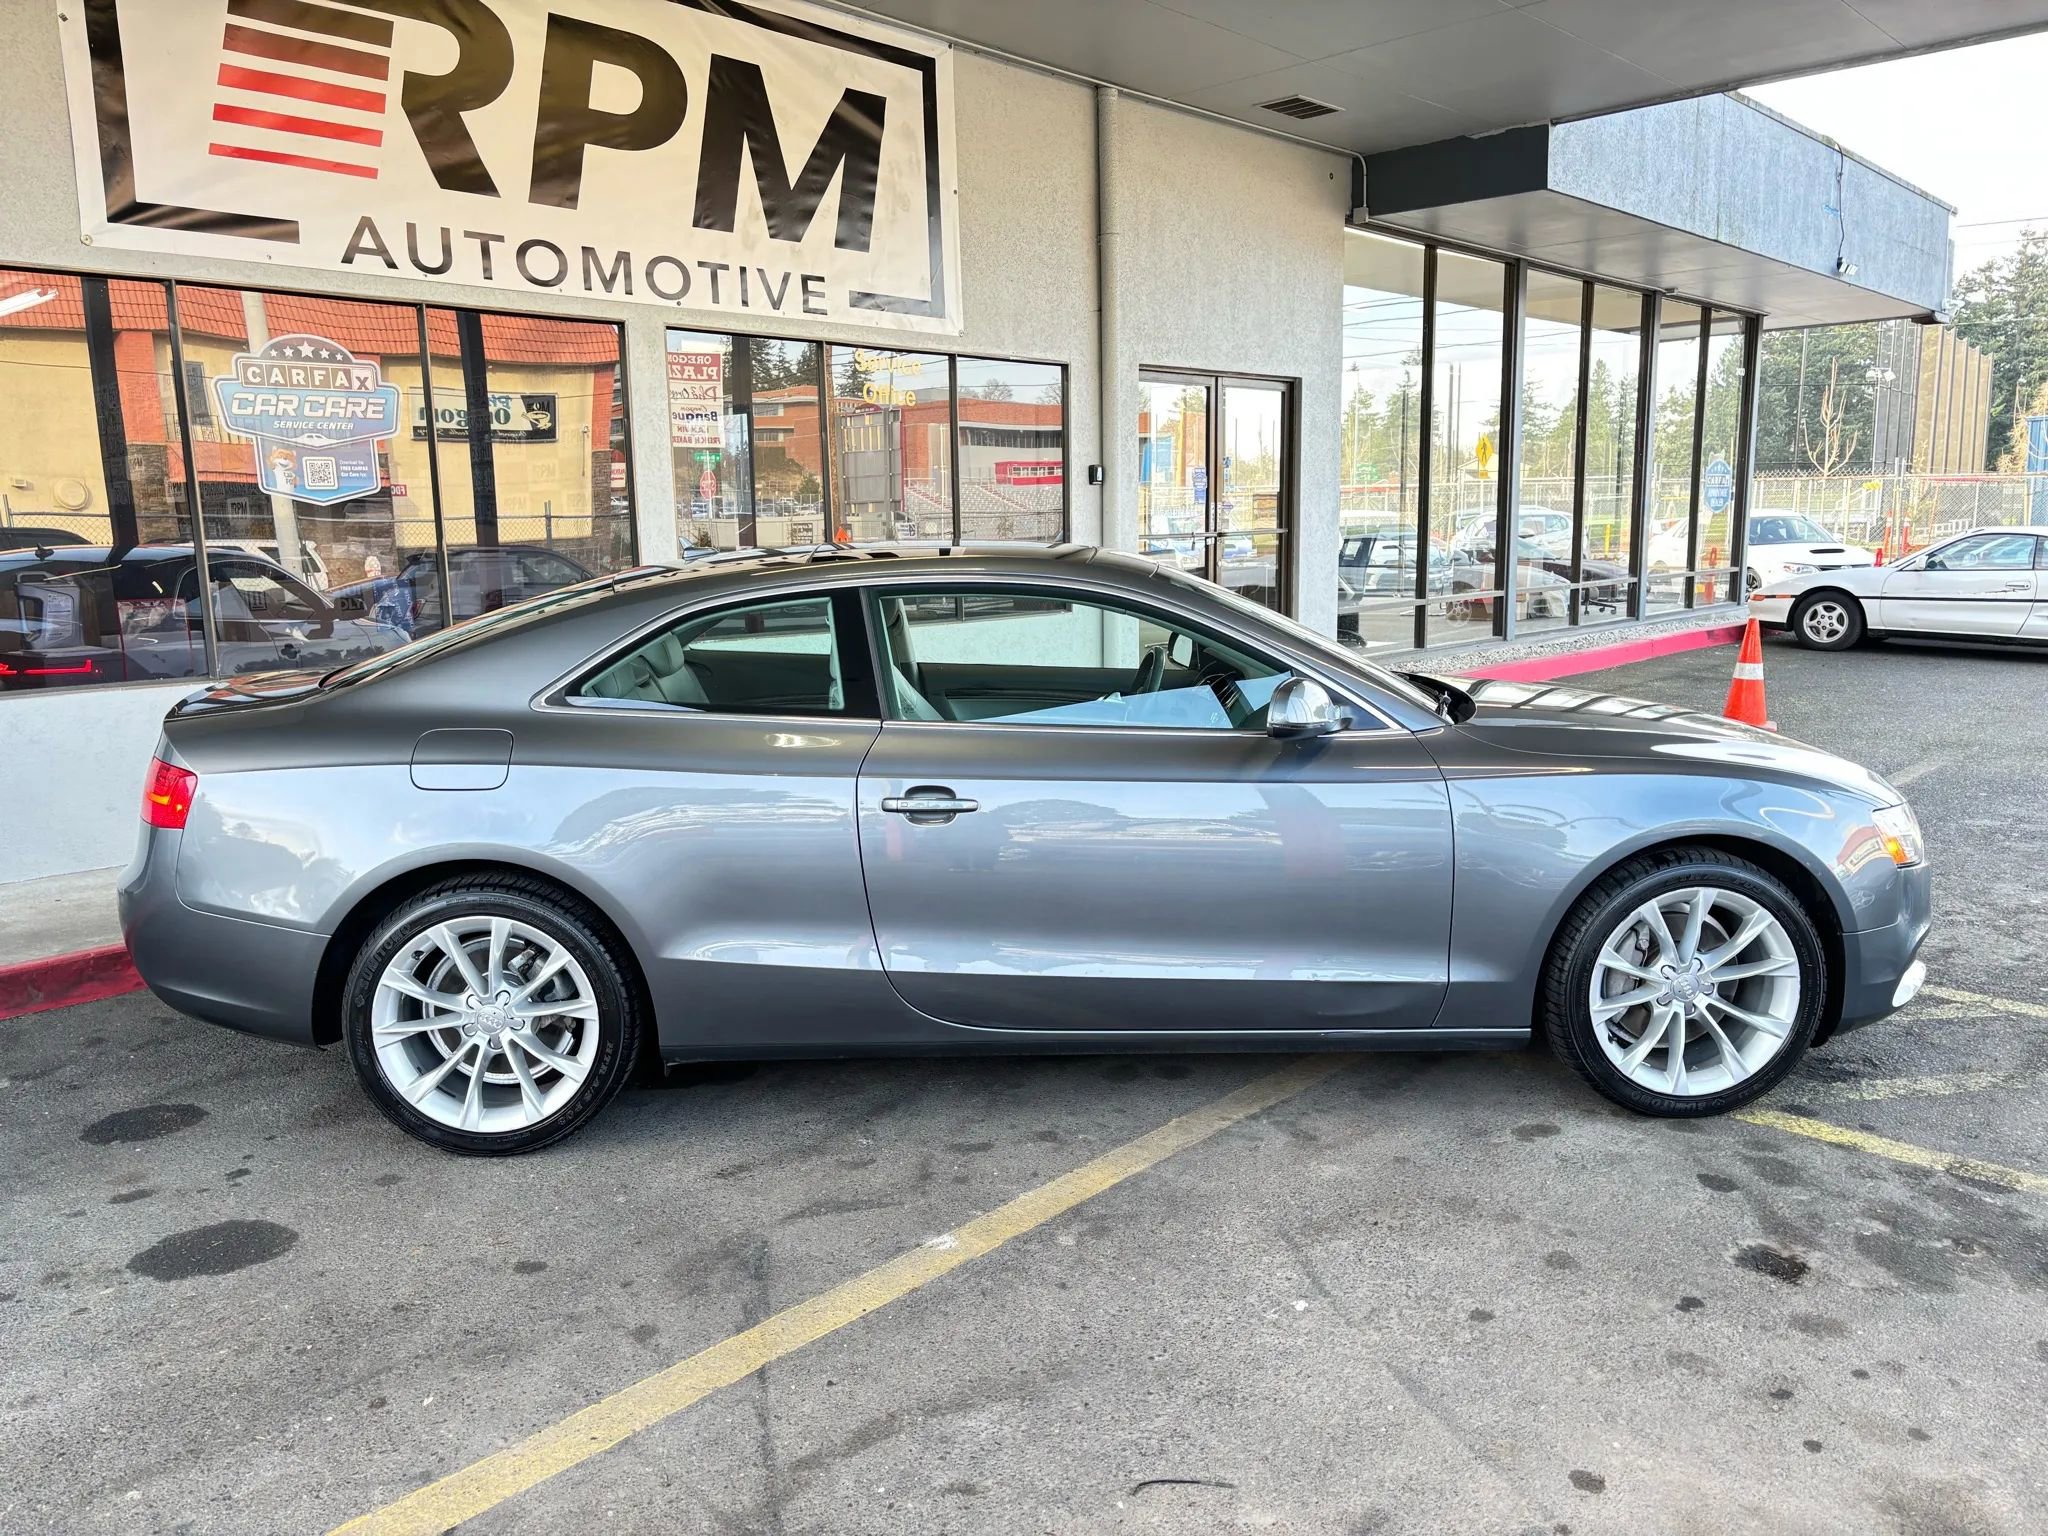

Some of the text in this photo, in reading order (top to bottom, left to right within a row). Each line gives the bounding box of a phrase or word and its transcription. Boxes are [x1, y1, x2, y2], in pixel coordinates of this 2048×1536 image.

[208, 0, 886, 253] RPM
[341, 216, 827, 315] AUTOMOTIVE
[854, 347, 920, 374] Service
[246, 366, 370, 391] CARFAX
[231, 392, 387, 420] CAR CARE
[863, 382, 917, 407] Office
[273, 420, 354, 430] SERVICE CENTER
